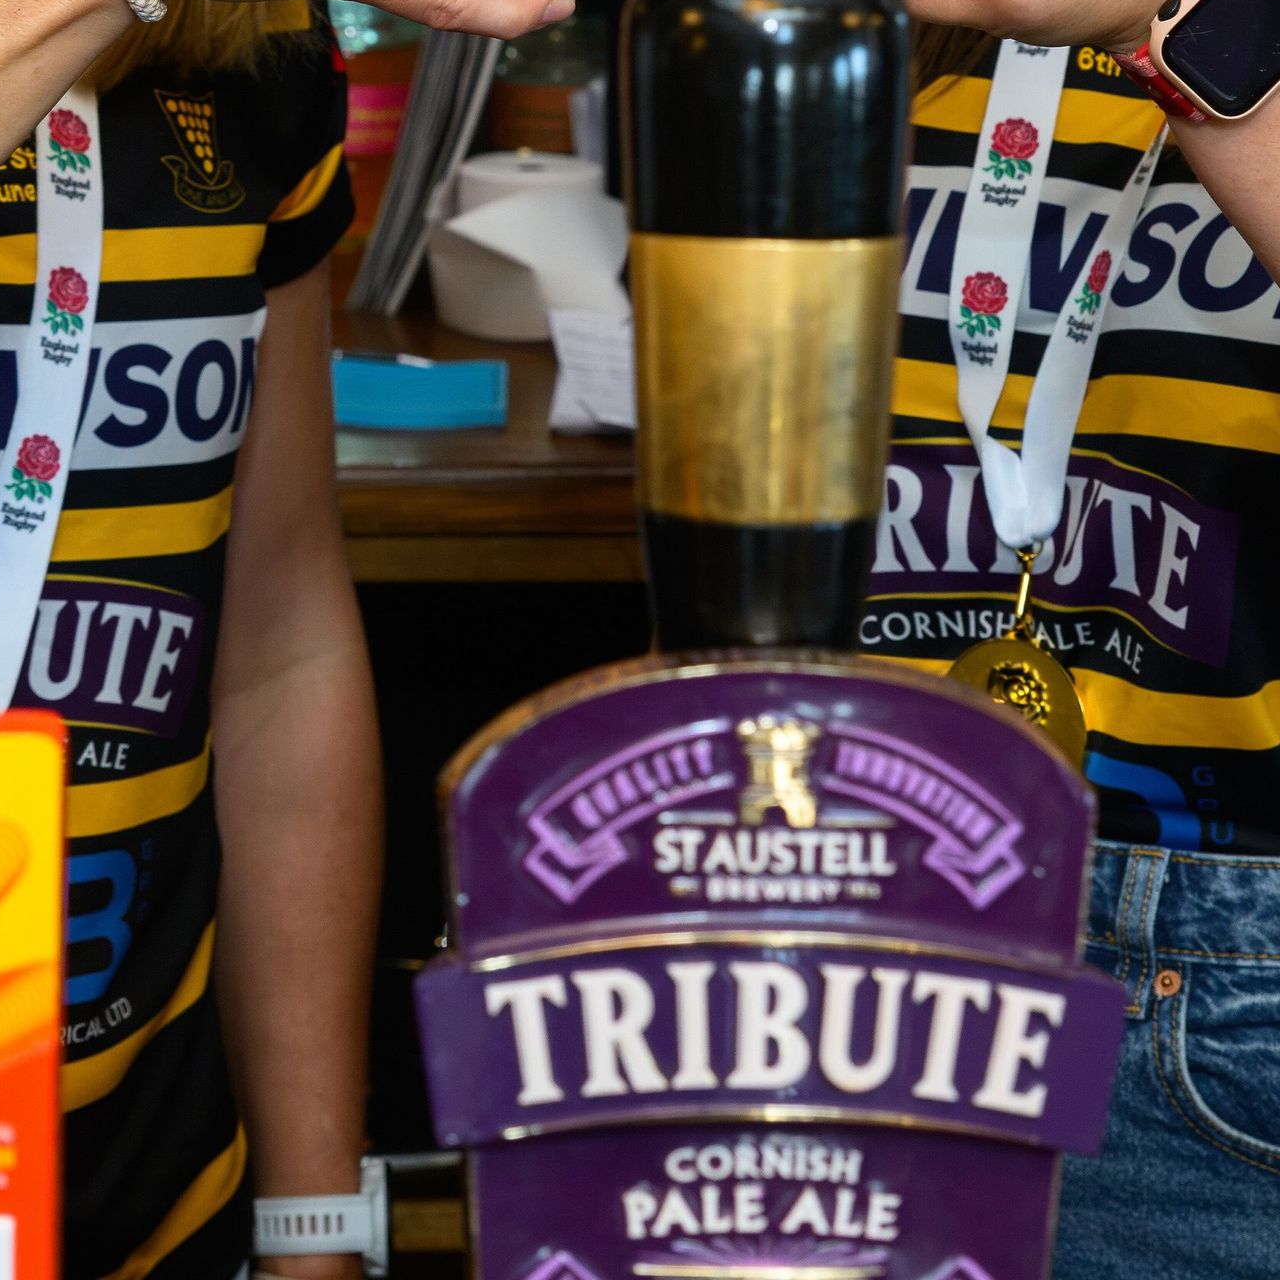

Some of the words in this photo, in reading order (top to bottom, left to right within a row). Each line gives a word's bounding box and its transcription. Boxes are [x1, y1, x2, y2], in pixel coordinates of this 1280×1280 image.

[50, 172, 91, 191] England
[54, 184, 87, 202] Rugby
[980, 182, 1027, 198] England
[982, 193, 1020, 209] Rugby
[40, 335, 79, 355] England
[42, 349, 73, 368] Rugby
[1, 502, 46, 523] England
[2, 514, 37, 534] Rugby
[858, 609, 1015, 645] CORNISH
[1032, 617, 1093, 652] ALE
[1104, 627, 1146, 676] ALE
[77, 741, 130, 771] ALE
[653, 829, 705, 873] ST
[702, 830, 899, 877] AUSTELL
[705, 876, 842, 903] BREWERY
[105, 995, 132, 1028] LTD
[484, 960, 1068, 1119] TRIBUTE
[664, 1144, 863, 1185] CORNISH
[622, 1186, 768, 1241] PALE
[780, 1186, 902, 1243] ALE
